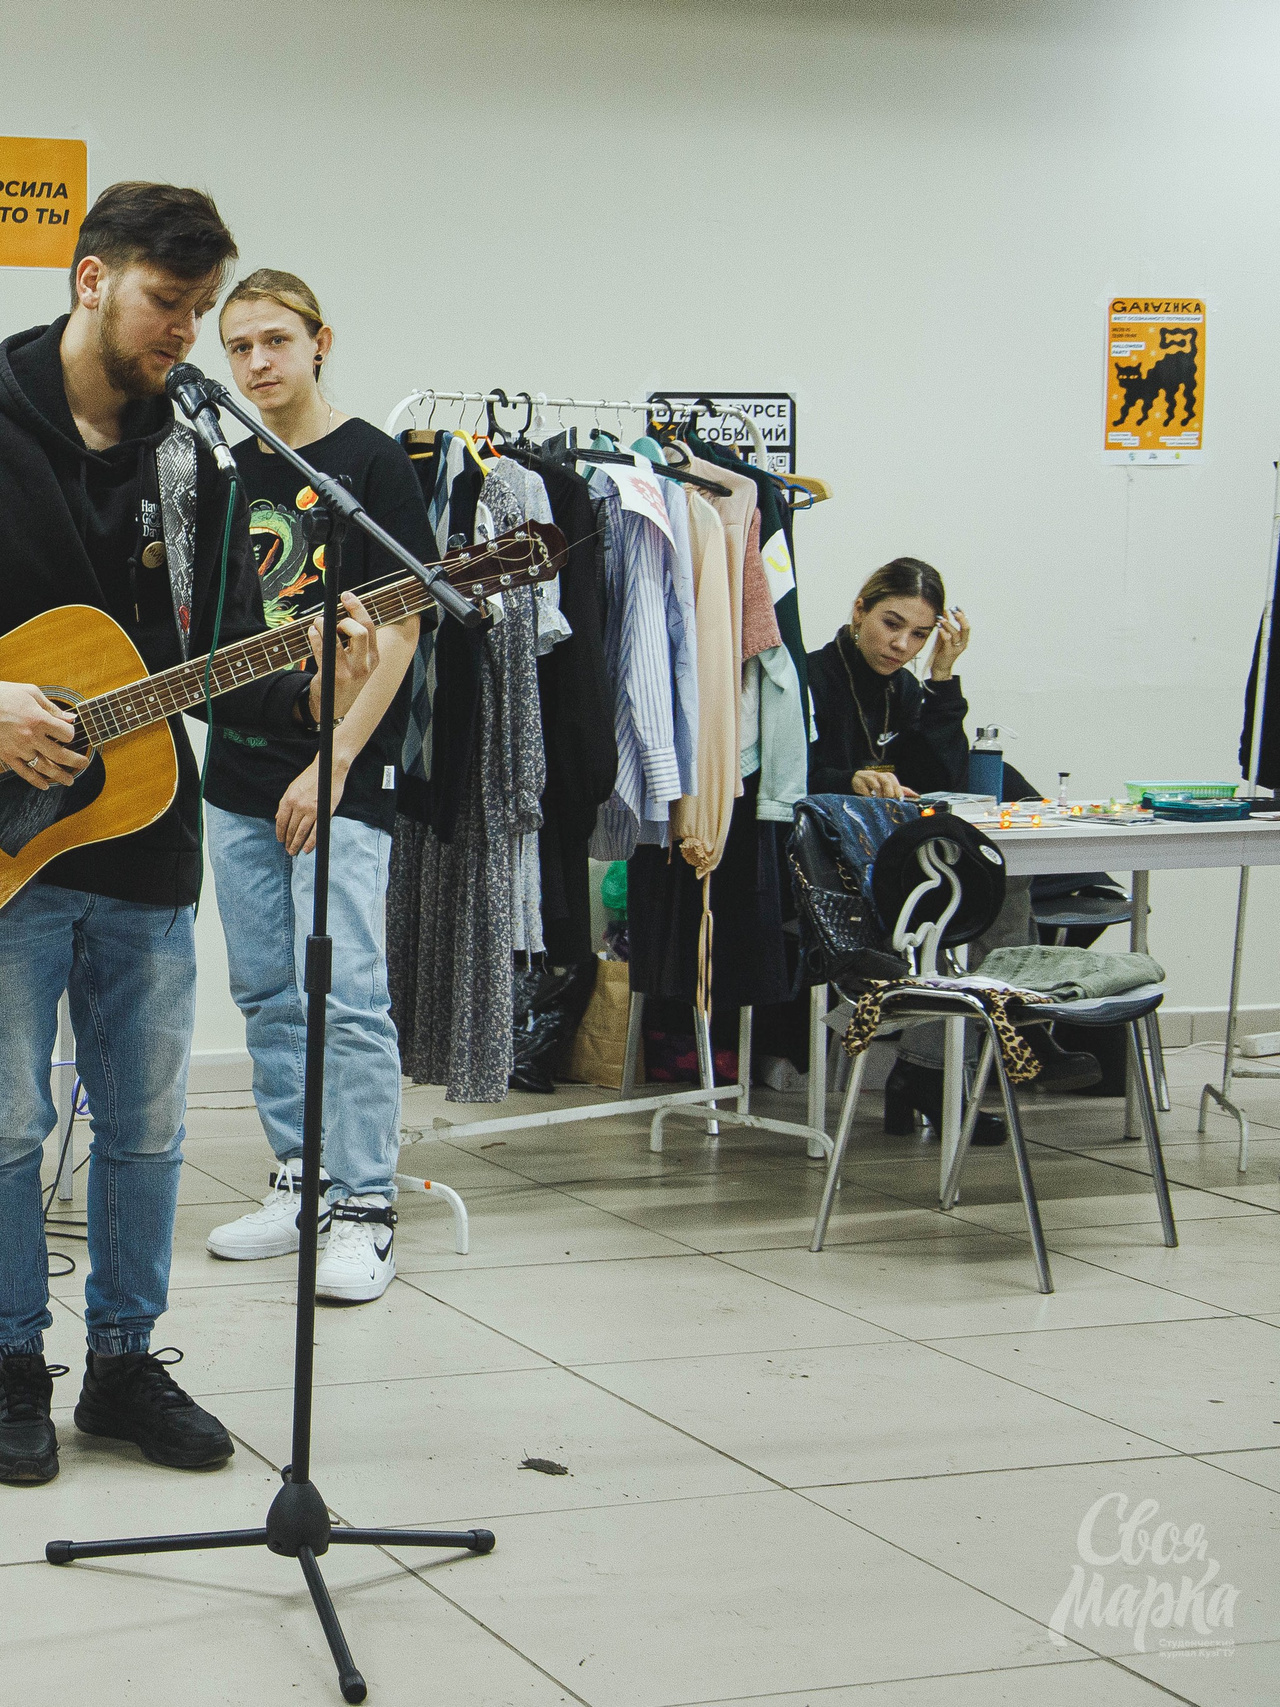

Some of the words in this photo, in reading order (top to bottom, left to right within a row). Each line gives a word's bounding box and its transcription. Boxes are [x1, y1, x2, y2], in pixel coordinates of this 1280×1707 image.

[36, 208, 69, 225] ТЫ
[730, 404, 786, 418] УРСЕ
[697, 424, 786, 441] СОБЫИЙ
